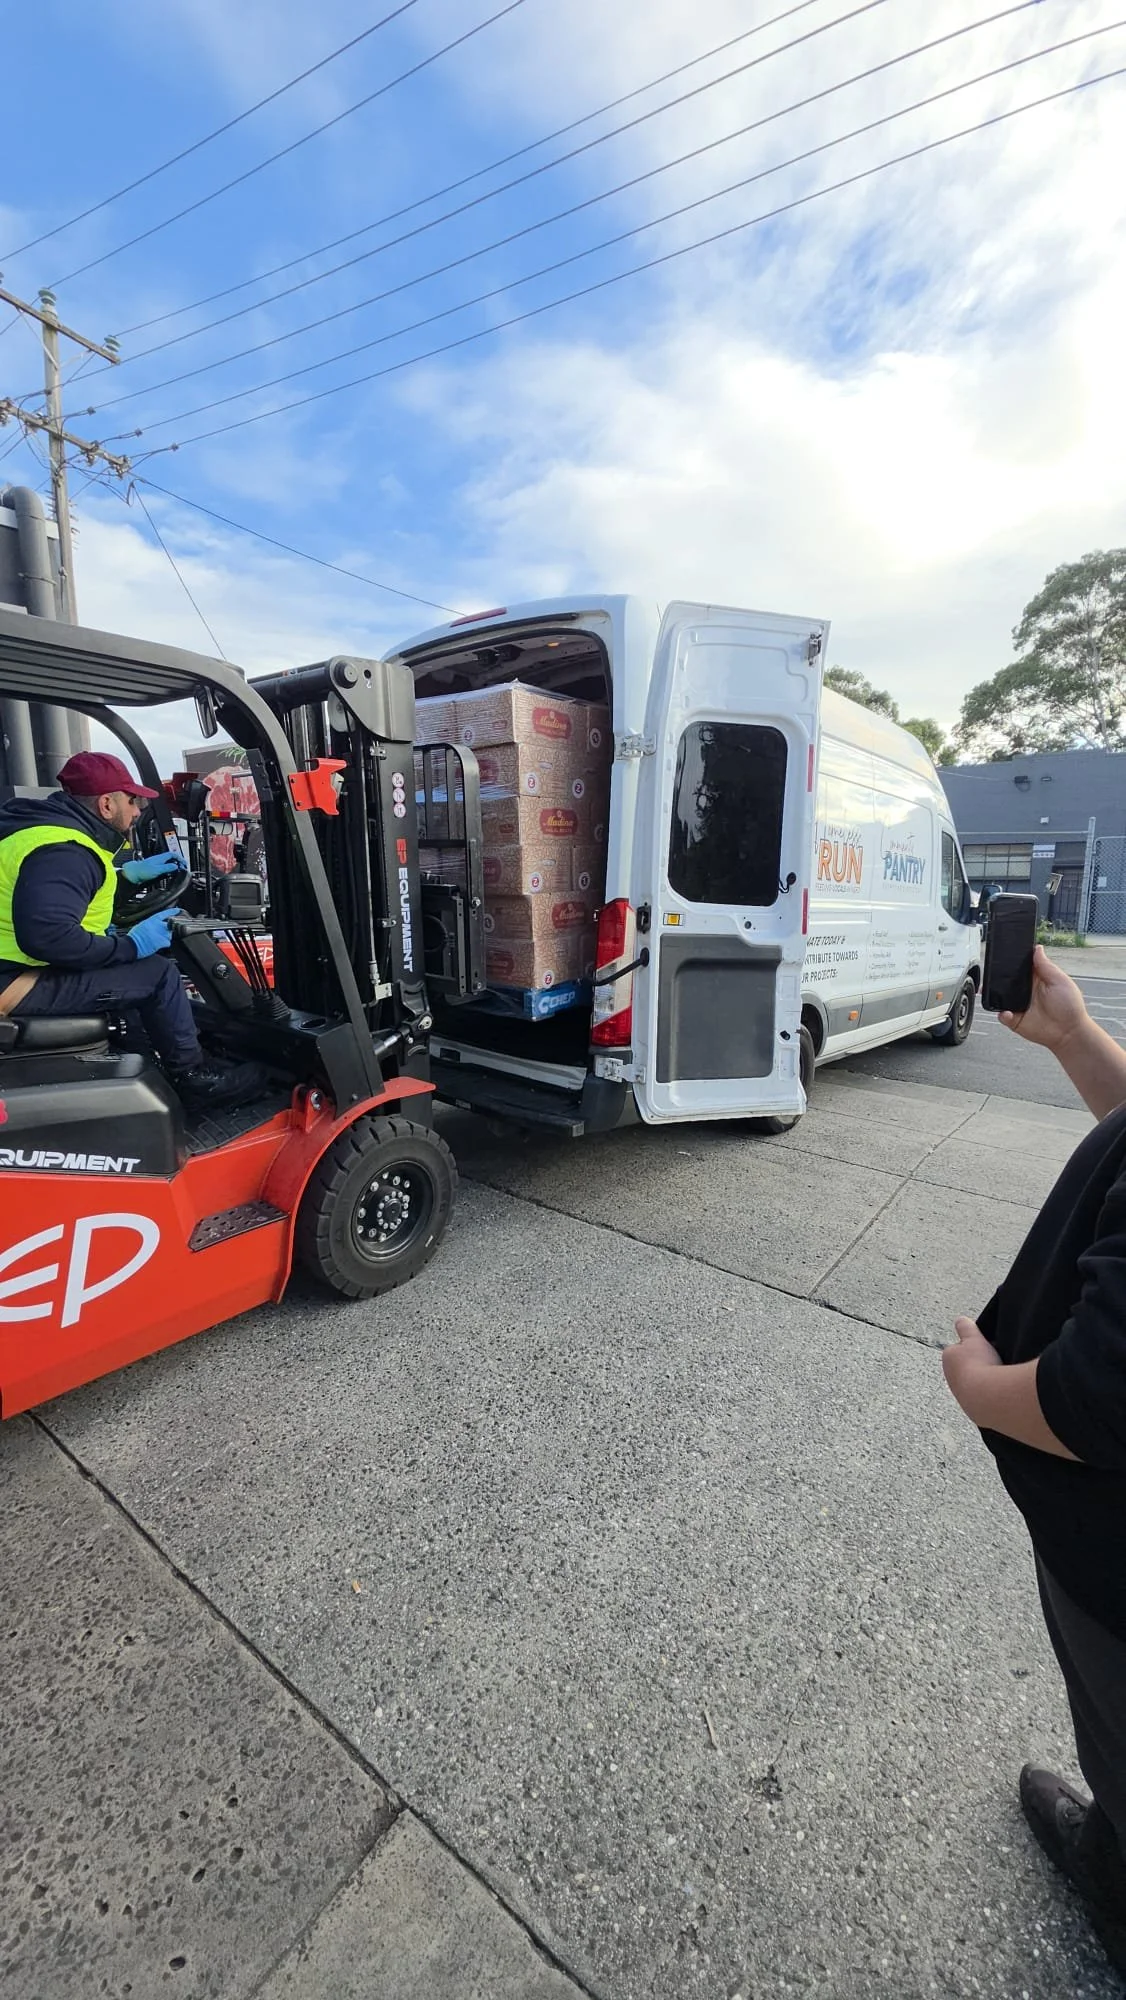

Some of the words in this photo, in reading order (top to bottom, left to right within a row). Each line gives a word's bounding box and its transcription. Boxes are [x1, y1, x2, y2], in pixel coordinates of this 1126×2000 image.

[396, 838, 408, 864] EP
[817, 838, 864, 884] RUN
[883, 850, 926, 885] PANTRY
[399, 867, 413, 973] EQUIPMENT
[821, 935, 842, 946] TODAY
[833, 950, 859, 962] TOWARDS
[0, 1213, 160, 1329] EP
